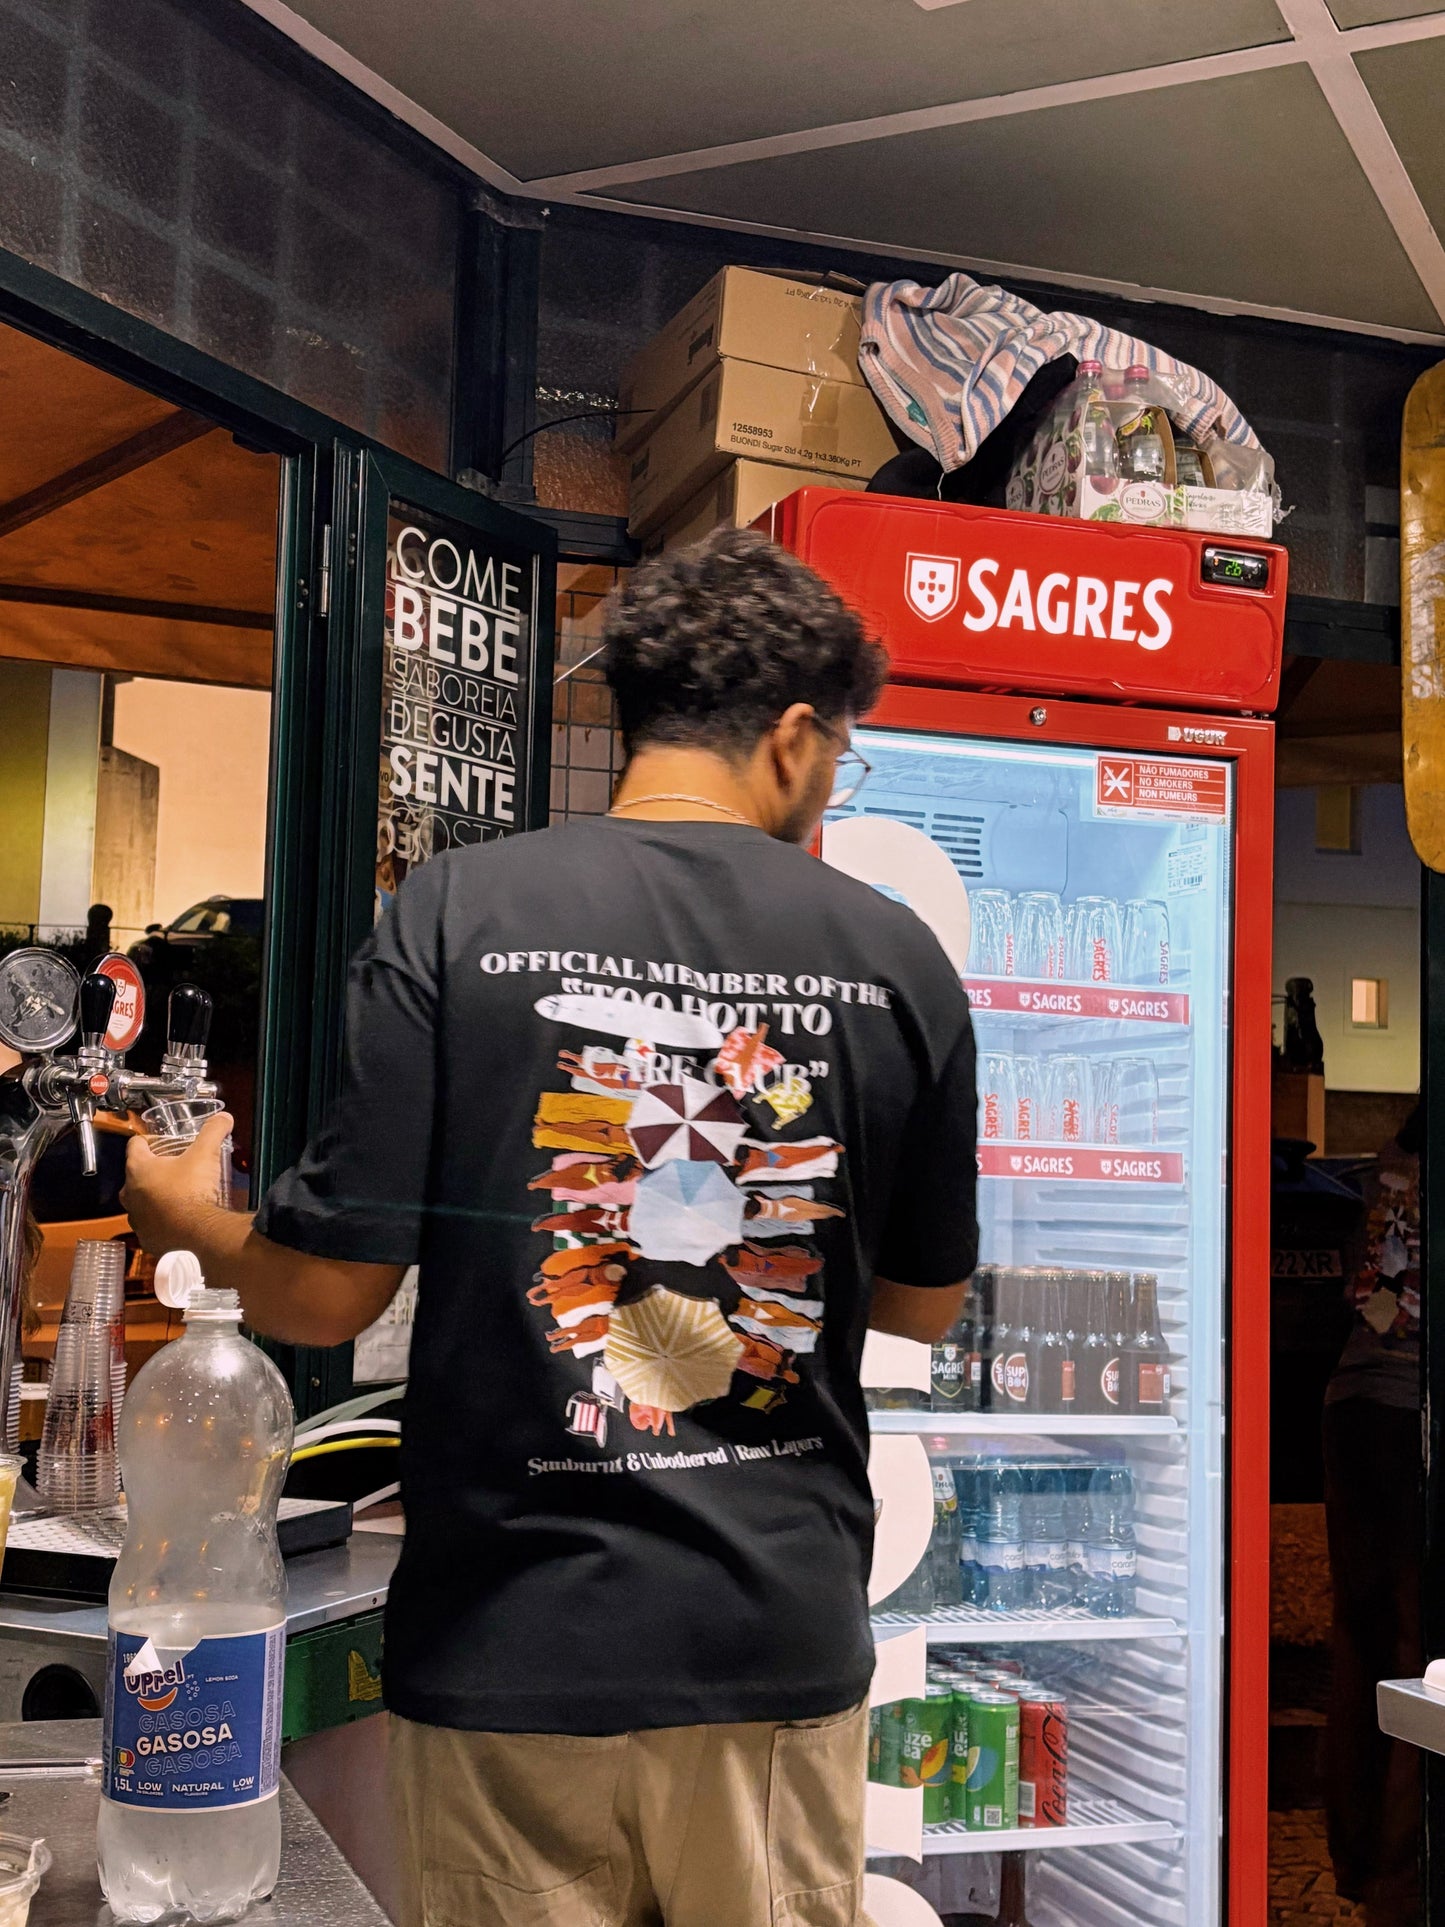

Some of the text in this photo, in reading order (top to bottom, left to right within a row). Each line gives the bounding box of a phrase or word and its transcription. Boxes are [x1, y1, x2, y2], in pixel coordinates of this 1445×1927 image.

[732, 422, 773, 438] 12558953
[730, 435, 761, 448] BUONDI
[762, 441, 783, 453] Sugar
[784, 445, 796, 455] Std
[851, 459, 862, 467] PT
[1125, 496, 1161, 508] PEDRAS
[396, 526, 522, 616] COME
[963, 558, 1174, 651] SAGRES
[393, 583, 520, 684] BEBE
[392, 657, 518, 723] SABOREIA
[390, 699, 516, 766] DEGUSTA
[389, 745, 516, 822] SENTE
[1139, 777, 1193, 790] NO SMOKERS
[1159, 766, 1209, 780] FUMADORES
[1139, 789, 1198, 802] NON FUMEURS
[388, 806, 505, 860] GOST
[1159, 940, 1169, 985] SAGRES
[480, 950, 895, 1010] OFFICIAL MEMBER OF THE
[112, 1000, 134, 1019] GRES
[681, 994, 768, 1034] HOT
[772, 1003, 833, 1036] TO
[1033, 992, 1082, 1013] SAGRES
[1121, 998, 1169, 1019] SAGRES
[984, 1093, 999, 1139] SAGRES
[1018, 1098, 1032, 1141] SAGRES
[1024, 1155, 1074, 1176] SAGRES
[1113, 1157, 1162, 1179] SAGRES
[931, 1360, 964, 1375] SAGRES
[527, 1456, 624, 1476] Sunburnt
[626, 1452, 640, 1472] &
[640, 1446, 729, 1470] Unbothered
[139, 1700, 236, 1734] GASOSA
[136, 1723, 233, 1756] GASOSA
[145, 1741, 242, 1777] GASOSA
[114, 1777, 133, 1792] 1,5L
[138, 1781, 162, 1791] LOW
[172, 1782, 225, 1792] NATURAL
[232, 1776, 255, 1788] LOW
